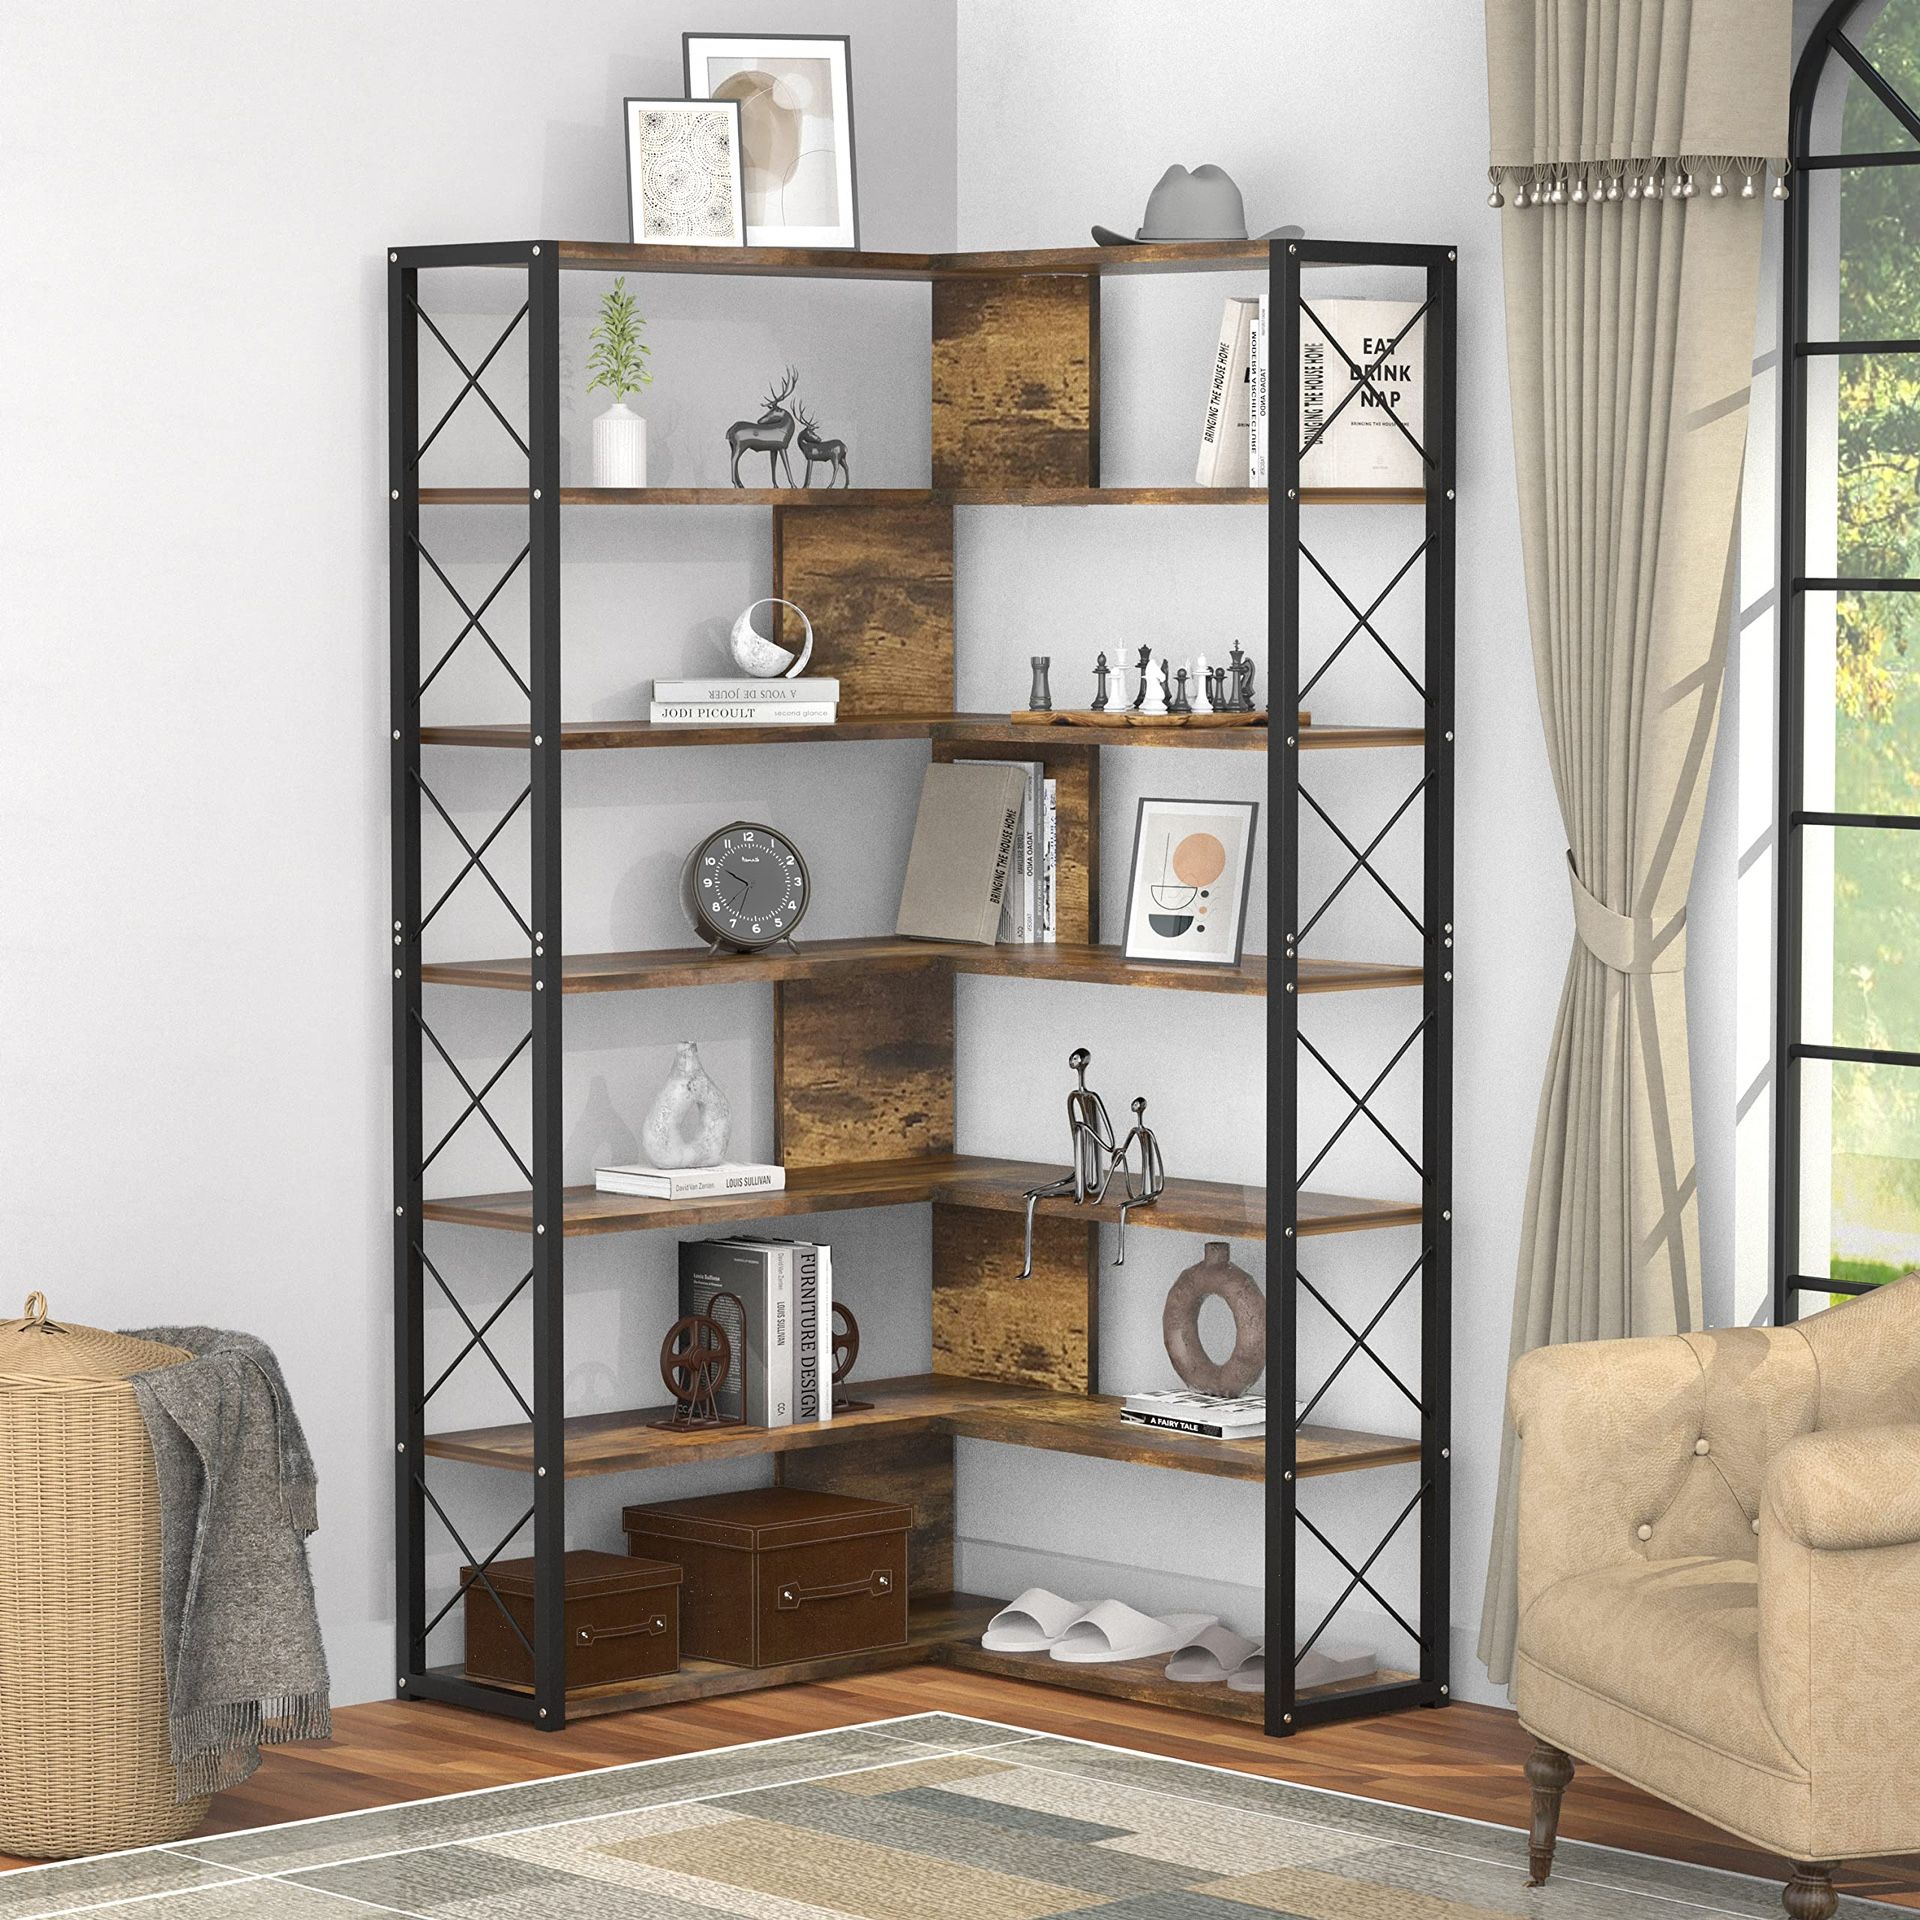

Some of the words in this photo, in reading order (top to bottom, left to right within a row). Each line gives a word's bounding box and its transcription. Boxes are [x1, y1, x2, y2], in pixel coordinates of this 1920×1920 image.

[1304, 343, 1323, 364] HOME
[1363, 338, 1397, 355] EAT
[1217, 342, 1230, 367] HOME
[1213, 364, 1226, 390] HOUSE
[1304, 366, 1323, 390] HOUSE
[1350, 364, 1411, 382] DRINK
[1210, 390, 1221, 407] THE
[1304, 392, 1323, 407] THE
[1361, 390, 1400, 408] NAP
[1204, 406, 1219, 443] BRINGING
[708, 687, 739, 699] JOUER
[744, 690, 756, 699] DE
[761, 689, 785, 699] VOUS
[790, 690, 797, 698] A
[661, 708, 692, 718] JODI
[698, 708, 755, 718] PICOULT
[774, 709, 800, 717] second
[803, 710, 828, 719] glance
[1004, 808, 1016, 830] HOME
[724, 839, 732, 848] 11
[743, 832, 754, 842] 12
[771, 839, 775, 848] 1
[1000, 829, 1013, 854] HOUSE
[705, 857, 716, 865] 10
[785, 855, 795, 865] 2
[997, 853, 1008, 871] THE
[703, 878, 712, 888] 9
[793, 877, 802, 886] 3
[990, 869, 1005, 904] BRINGING
[712, 902, 720, 912] 8
[788, 900, 796, 910] 4
[729, 919, 737, 928] 7
[752, 924, 761, 933] 6
[774, 918, 783, 927] 5
[726, 1178, 742, 1188] LOUIS
[744, 1175, 771, 1187] SULLIVAN
[801, 1253, 816, 1351] FURNITURE
[777, 1301, 785, 1318] LOUIS
[777, 1319, 785, 1346] SULLIVAN
[801, 1356, 816, 1417] DESIGN
[1158, 1418, 1179, 1428] FAIRY
[1180, 1422, 1199, 1432] TALE
